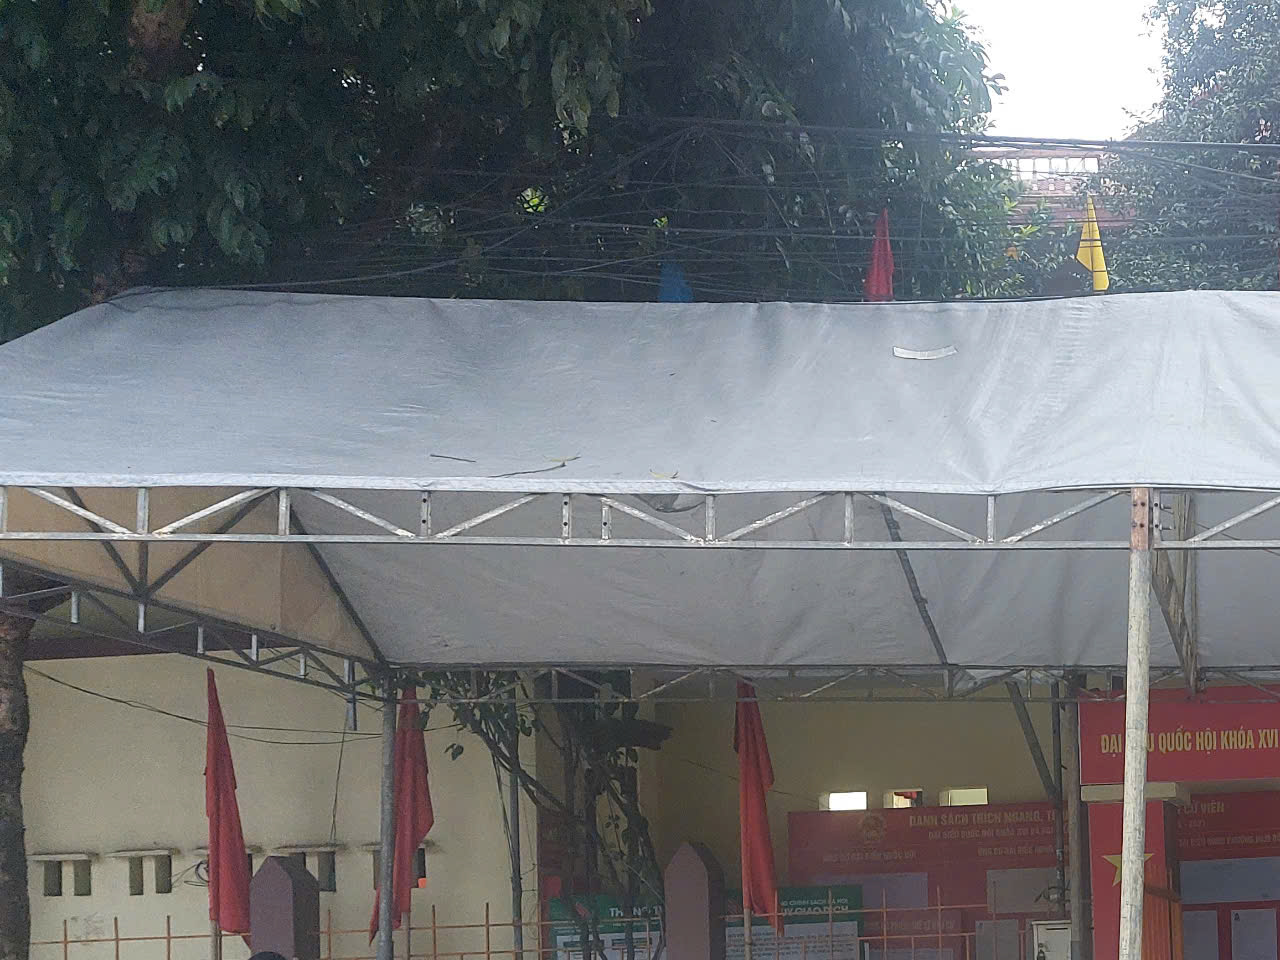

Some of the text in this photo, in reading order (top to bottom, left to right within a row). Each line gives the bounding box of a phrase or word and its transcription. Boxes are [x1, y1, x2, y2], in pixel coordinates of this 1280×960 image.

[1101, 733, 1122, 757] ĐẠI
[1158, 724, 1192, 754] QUỐC
[1196, 728, 1217, 755] HỘI
[1221, 724, 1255, 750] KHÓA
[1258, 729, 1279, 749] XVI
